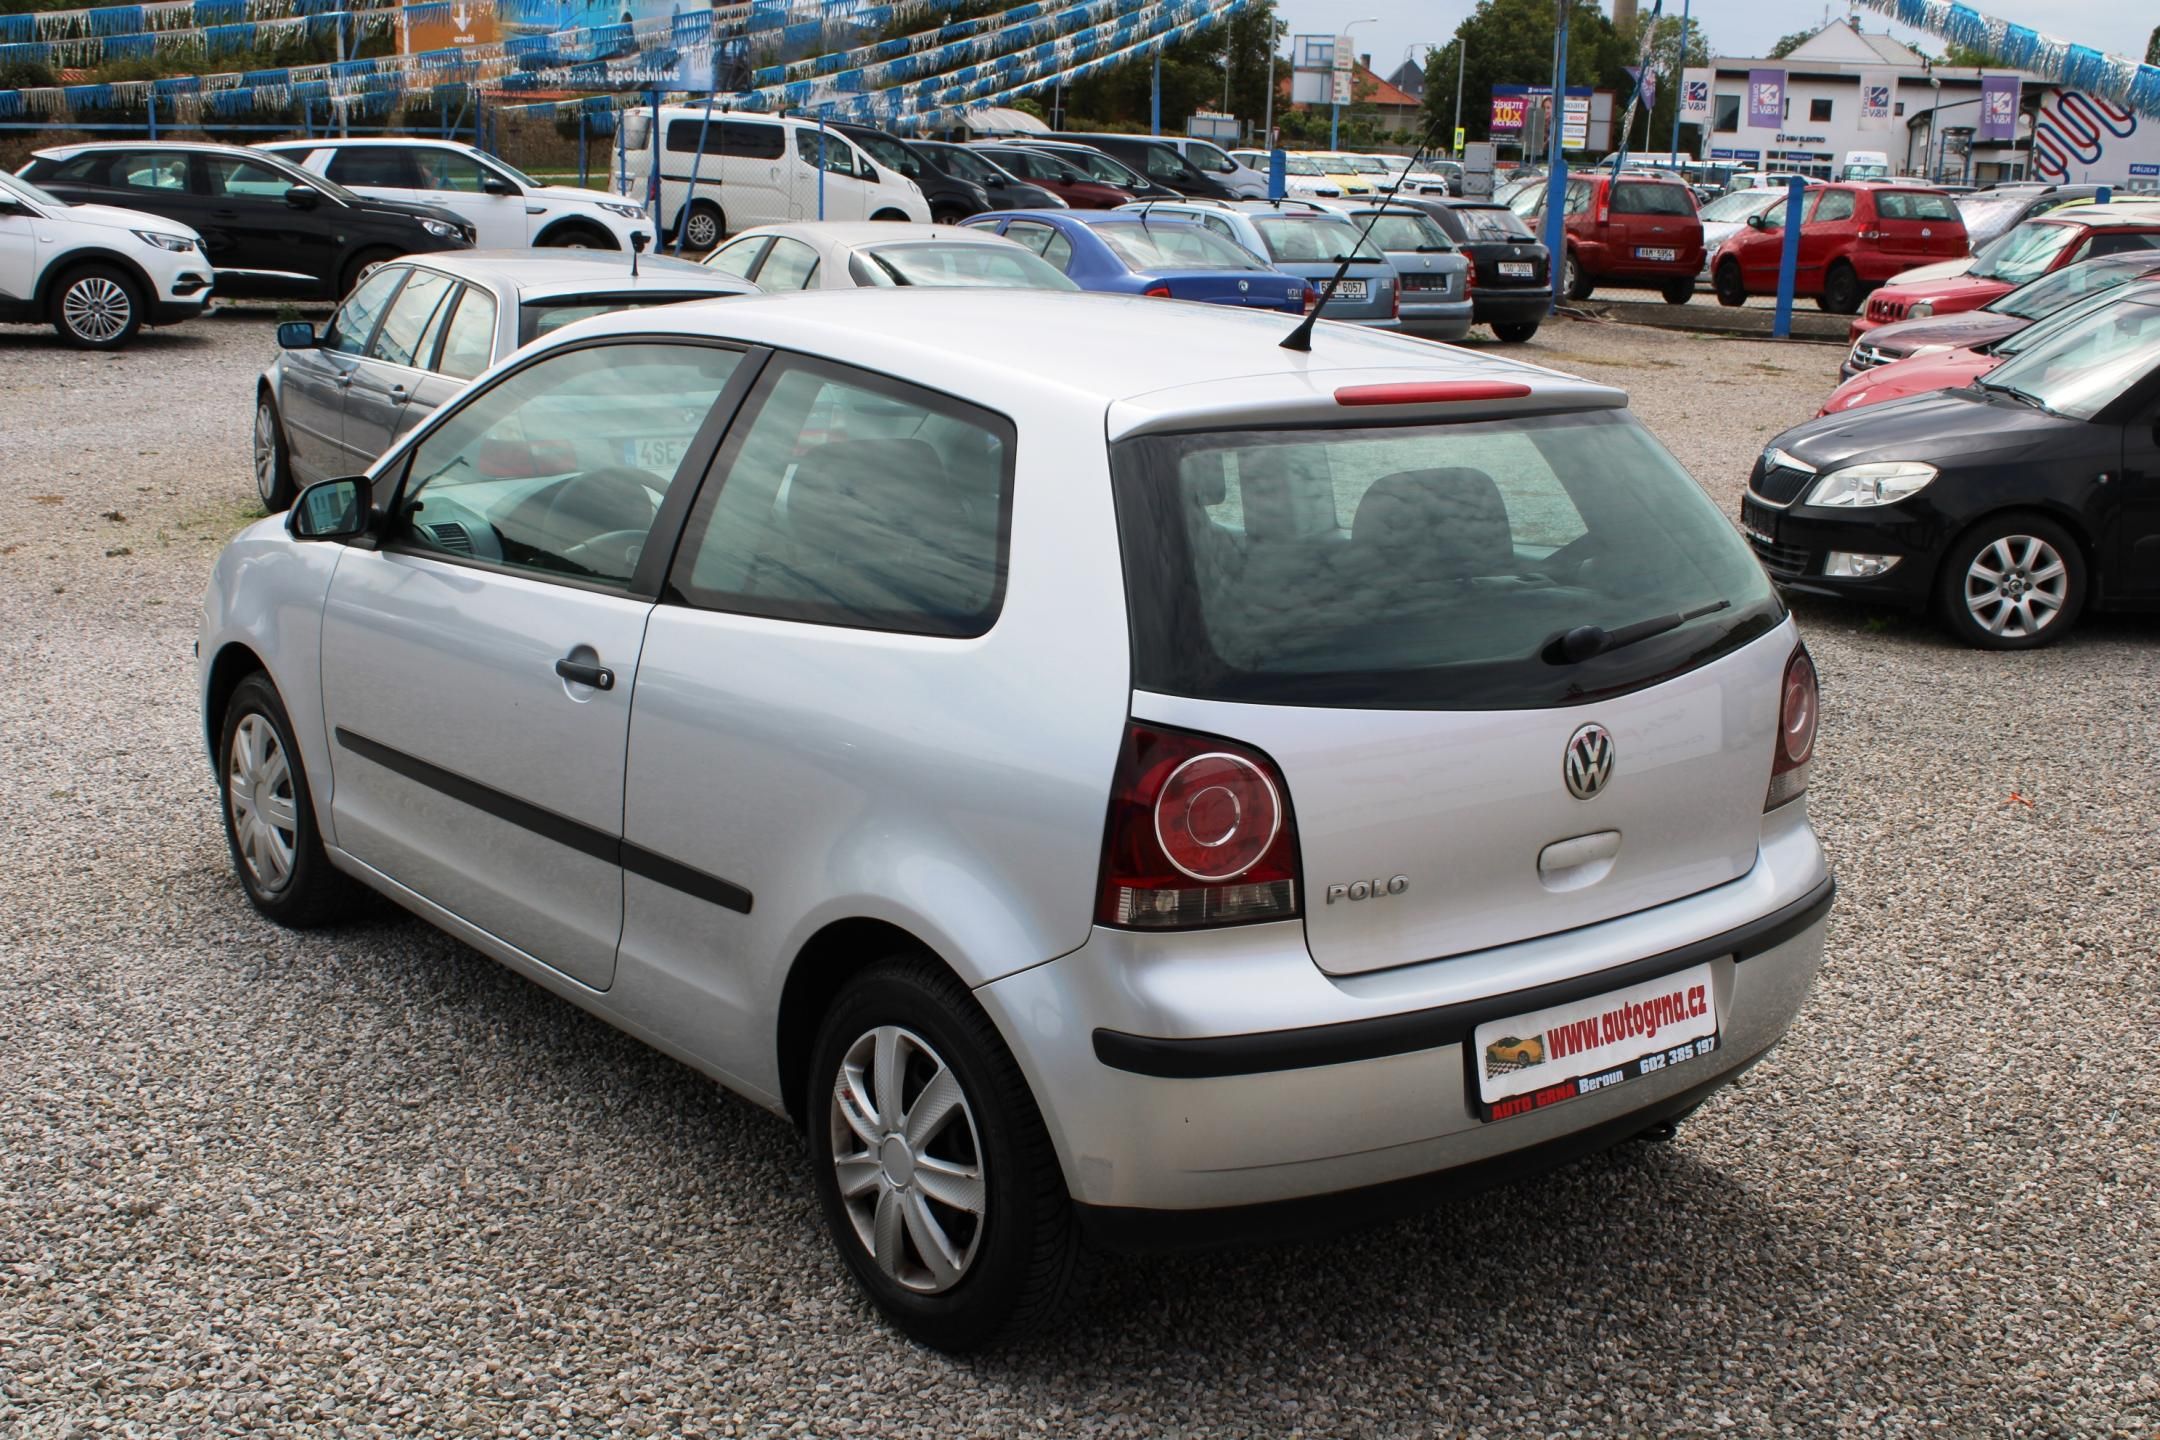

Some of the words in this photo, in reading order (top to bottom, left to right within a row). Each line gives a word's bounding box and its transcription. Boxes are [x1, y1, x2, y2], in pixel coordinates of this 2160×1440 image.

[1342, 281, 1363, 294] 6057
[1326, 873, 1411, 905] POLO
[1547, 984, 1707, 1060] www.autogrna.cz
[1491, 1094, 1532, 1121] AUTO
[1535, 1082, 1577, 1109] GRNA
[1578, 1069, 1625, 1095] Beroun
[1639, 1053, 1666, 1076] 602
[1668, 1043, 1695, 1066] 385
[1695, 1036, 1716, 1056] 197
